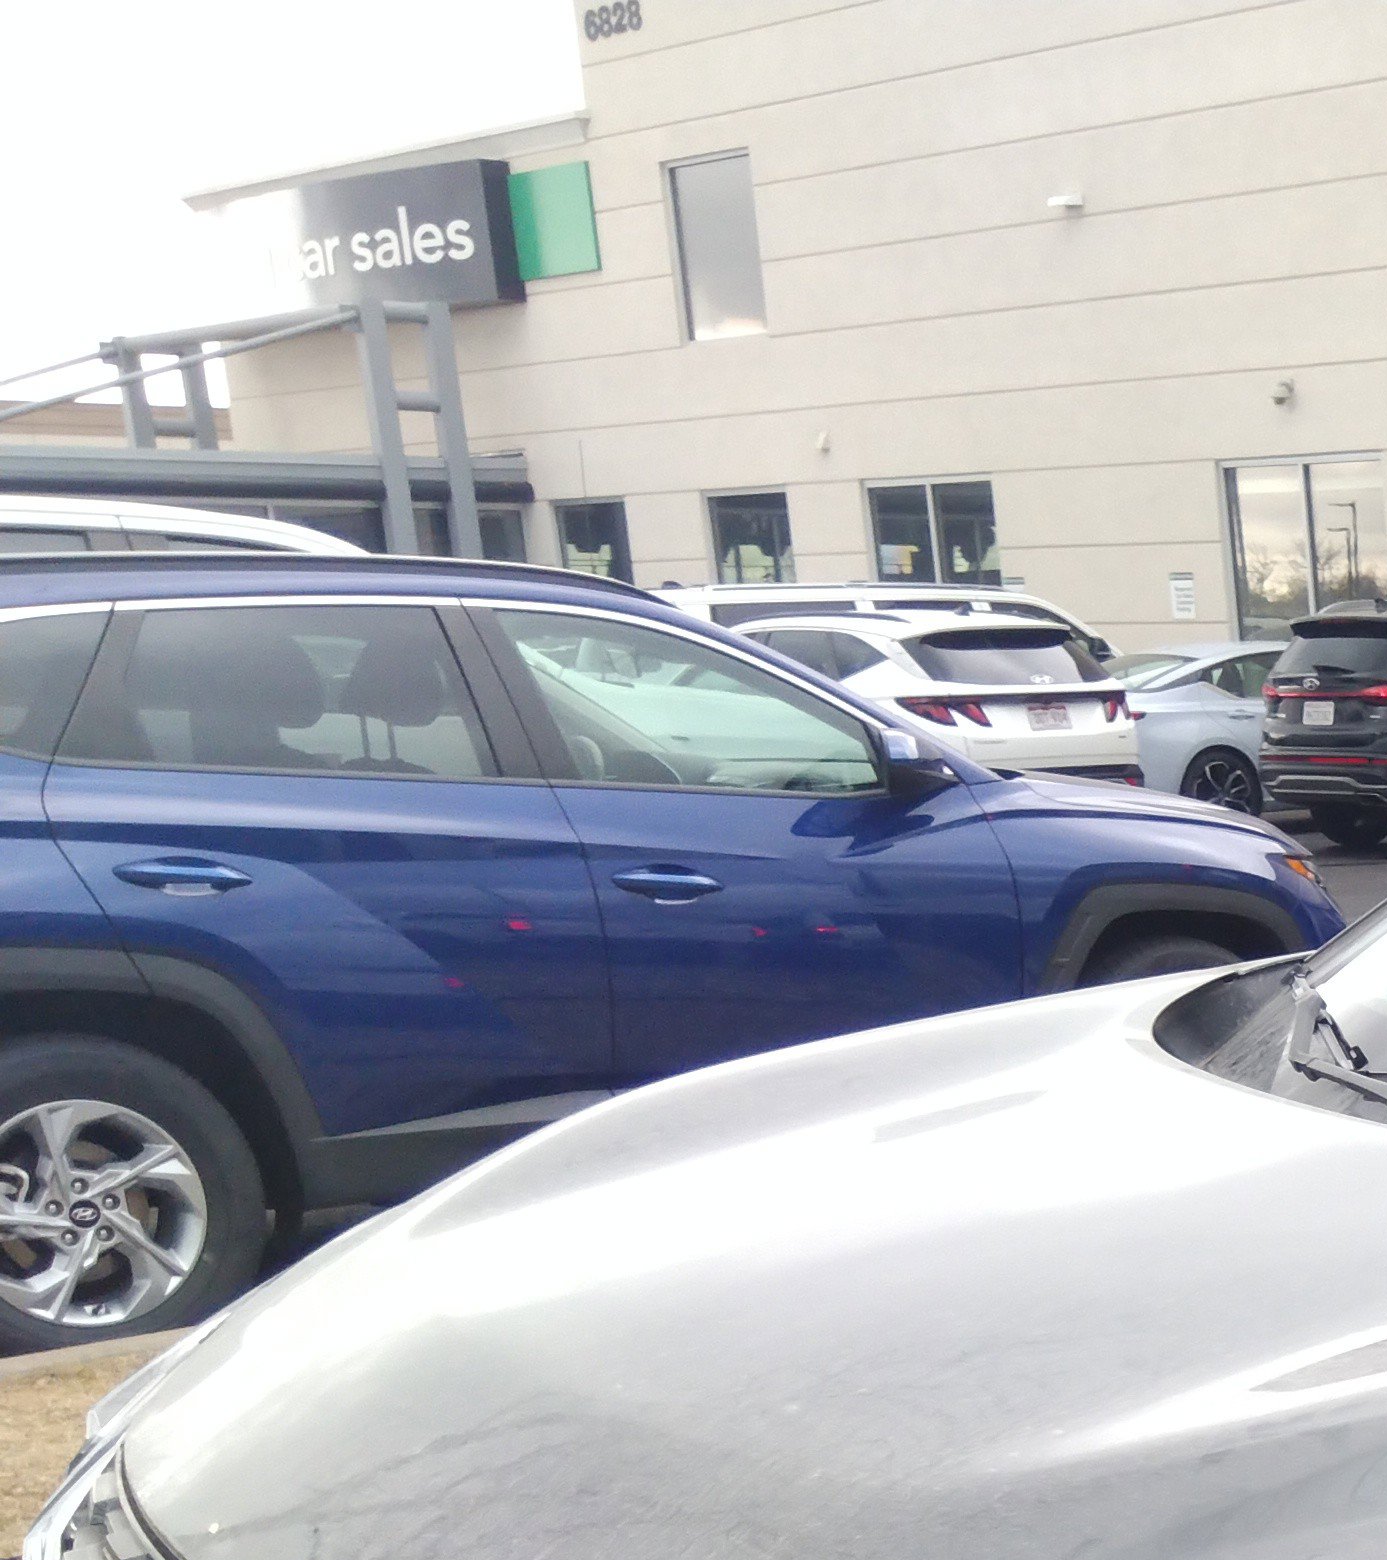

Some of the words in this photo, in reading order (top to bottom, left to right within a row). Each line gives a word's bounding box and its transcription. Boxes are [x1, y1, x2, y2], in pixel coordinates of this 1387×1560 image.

[584, 0, 643, 42] 6828
[290, 235, 340, 280] ar
[350, 205, 475, 272] sales
